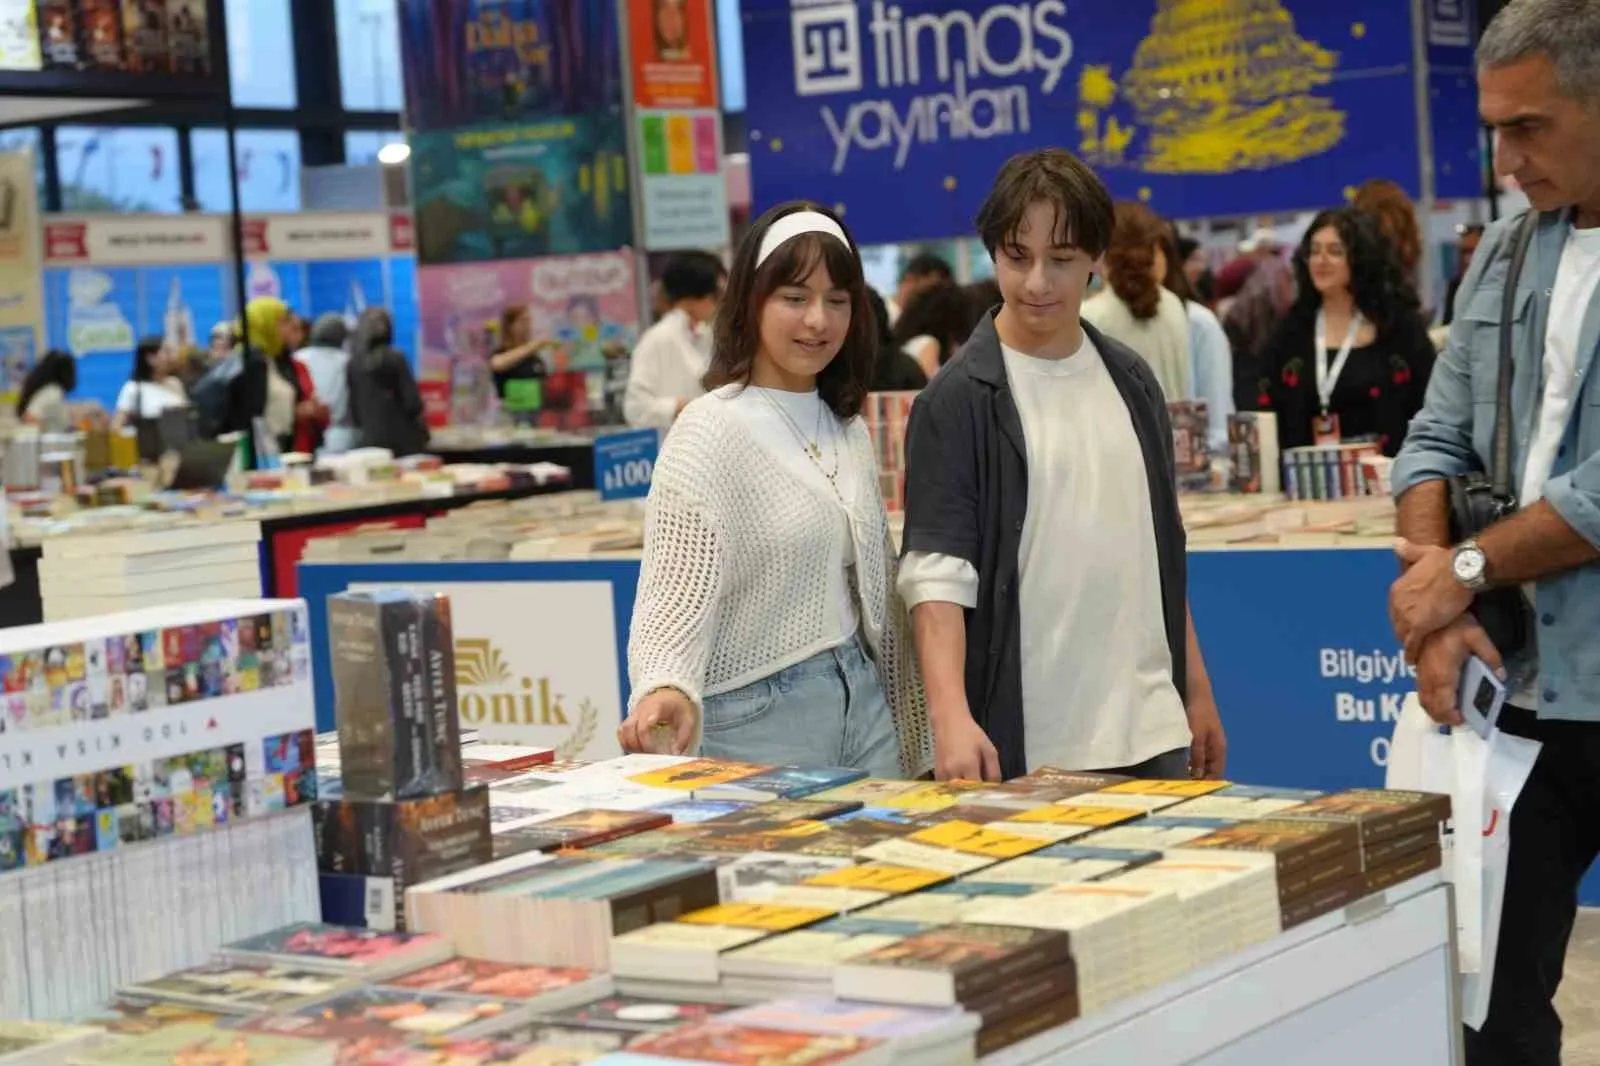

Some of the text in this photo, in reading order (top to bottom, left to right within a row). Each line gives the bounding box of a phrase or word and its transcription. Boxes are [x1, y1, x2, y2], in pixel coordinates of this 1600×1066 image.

[869, 0, 1074, 94] timaş
[459, 677, 569, 725] onik
[1336, 692, 1375, 721] Bu
